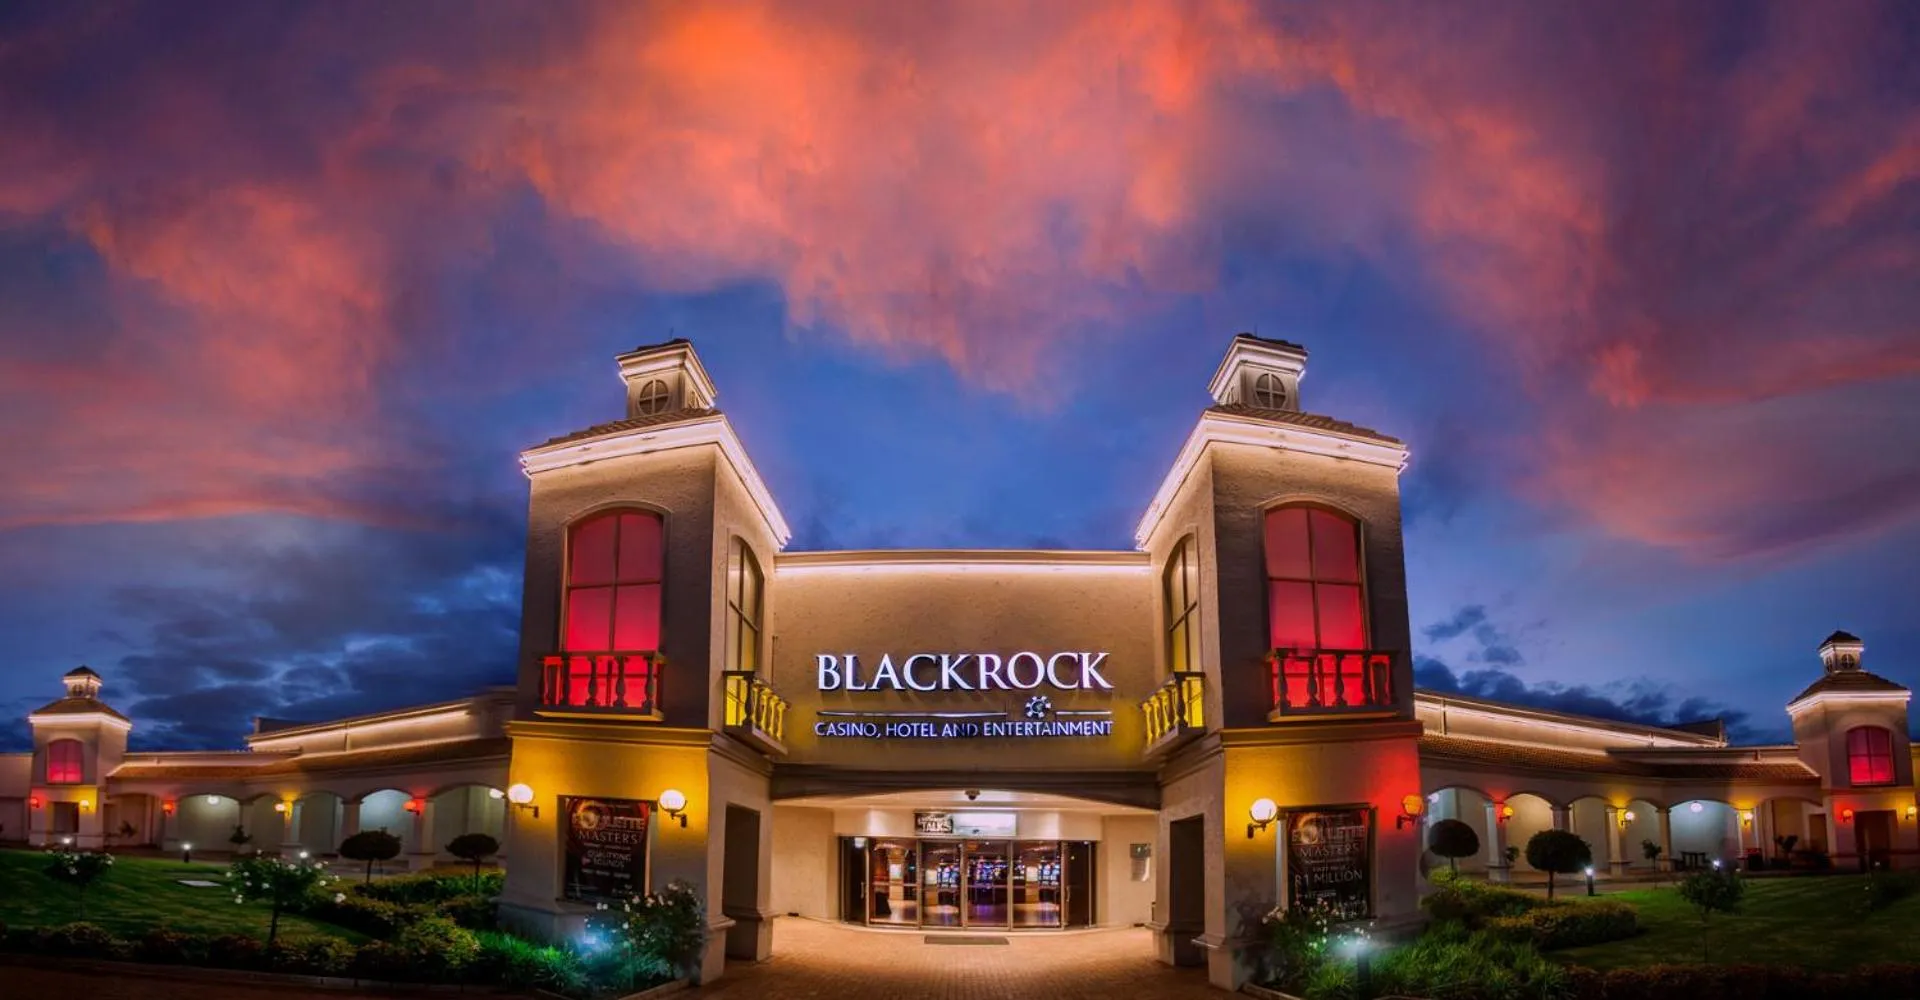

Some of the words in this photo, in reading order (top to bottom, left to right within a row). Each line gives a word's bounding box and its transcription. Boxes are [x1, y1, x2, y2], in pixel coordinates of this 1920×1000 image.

[816, 652, 1114, 691] BLACKROCK
[814, 722, 880, 738] CASINO,
[886, 722, 938, 738] HOTEL
[941, 722, 978, 737] AND
[983, 720, 1113, 737] ENTERTAINMENT
[579, 831, 638, 844] MASTERS
[1300, 844, 1360, 857] MASTERS
[1313, 869, 1363, 883] MILLION
